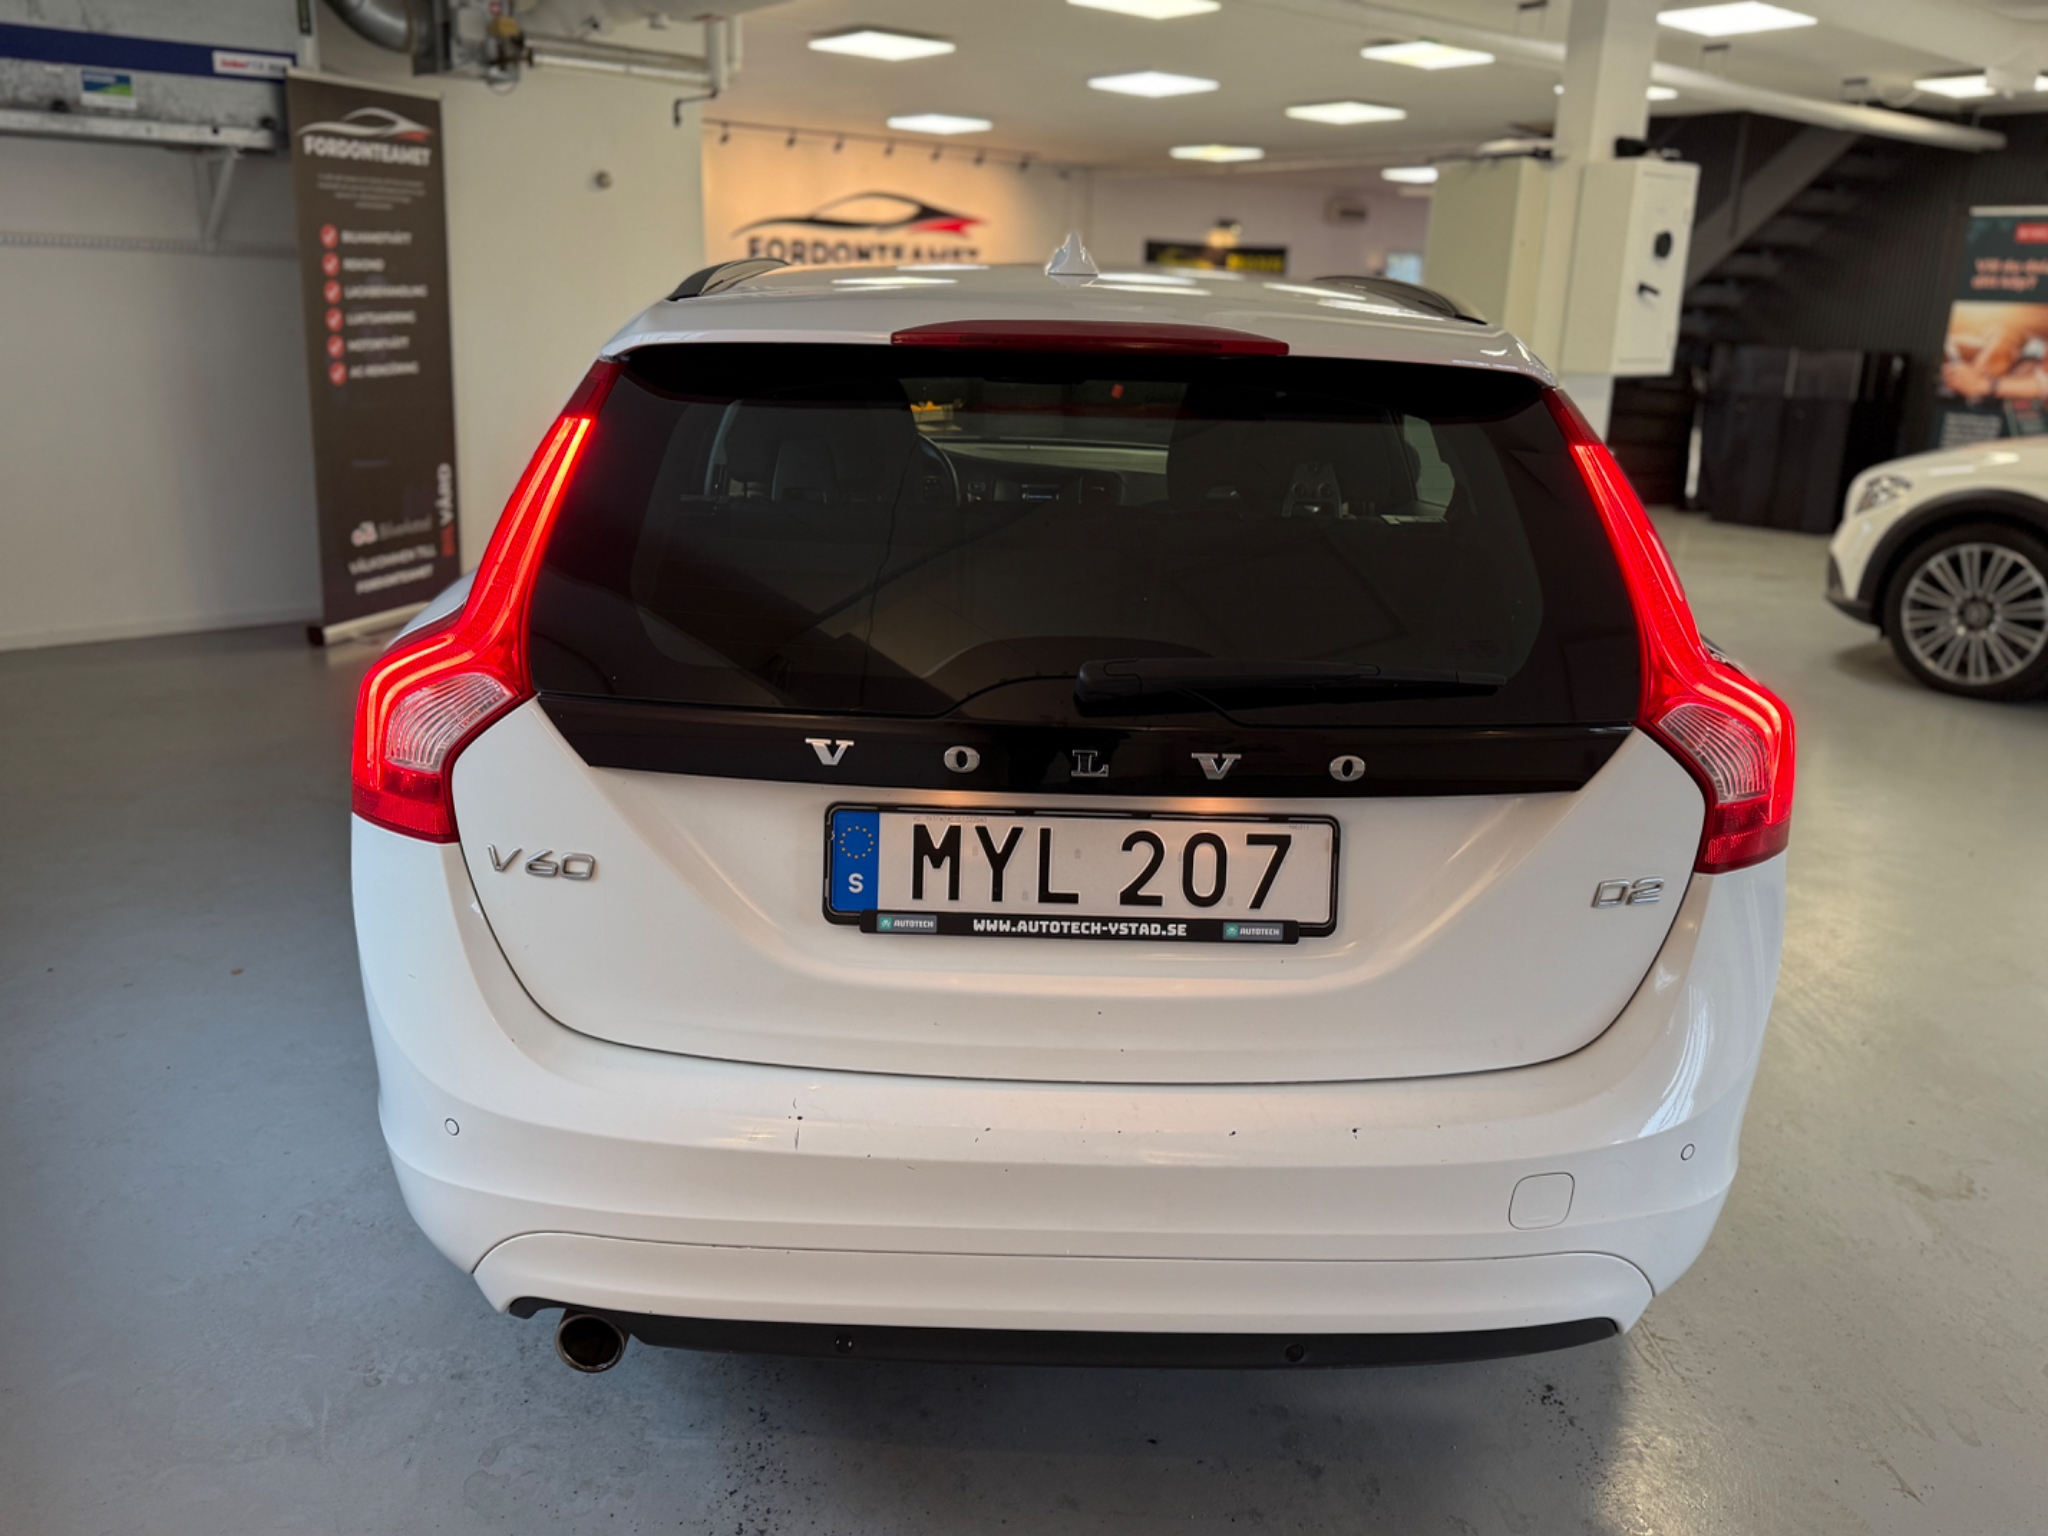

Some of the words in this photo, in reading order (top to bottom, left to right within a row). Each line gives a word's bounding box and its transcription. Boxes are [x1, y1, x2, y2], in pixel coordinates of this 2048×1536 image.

[805, 737, 1367, 782] VOLVO
[487, 843, 596, 882] V60
[911, 823, 1080, 904] MYL
[1118, 829, 1292, 910] 207
[848, 871, 865, 895] S
[1590, 876, 1665, 909] D2
[893, 919, 934, 929] AUTOTECH
[973, 918, 1188, 938] WWW.AUTOTECH-YSTAD.SE
[1239, 927, 1280, 936] AUTOTECH
